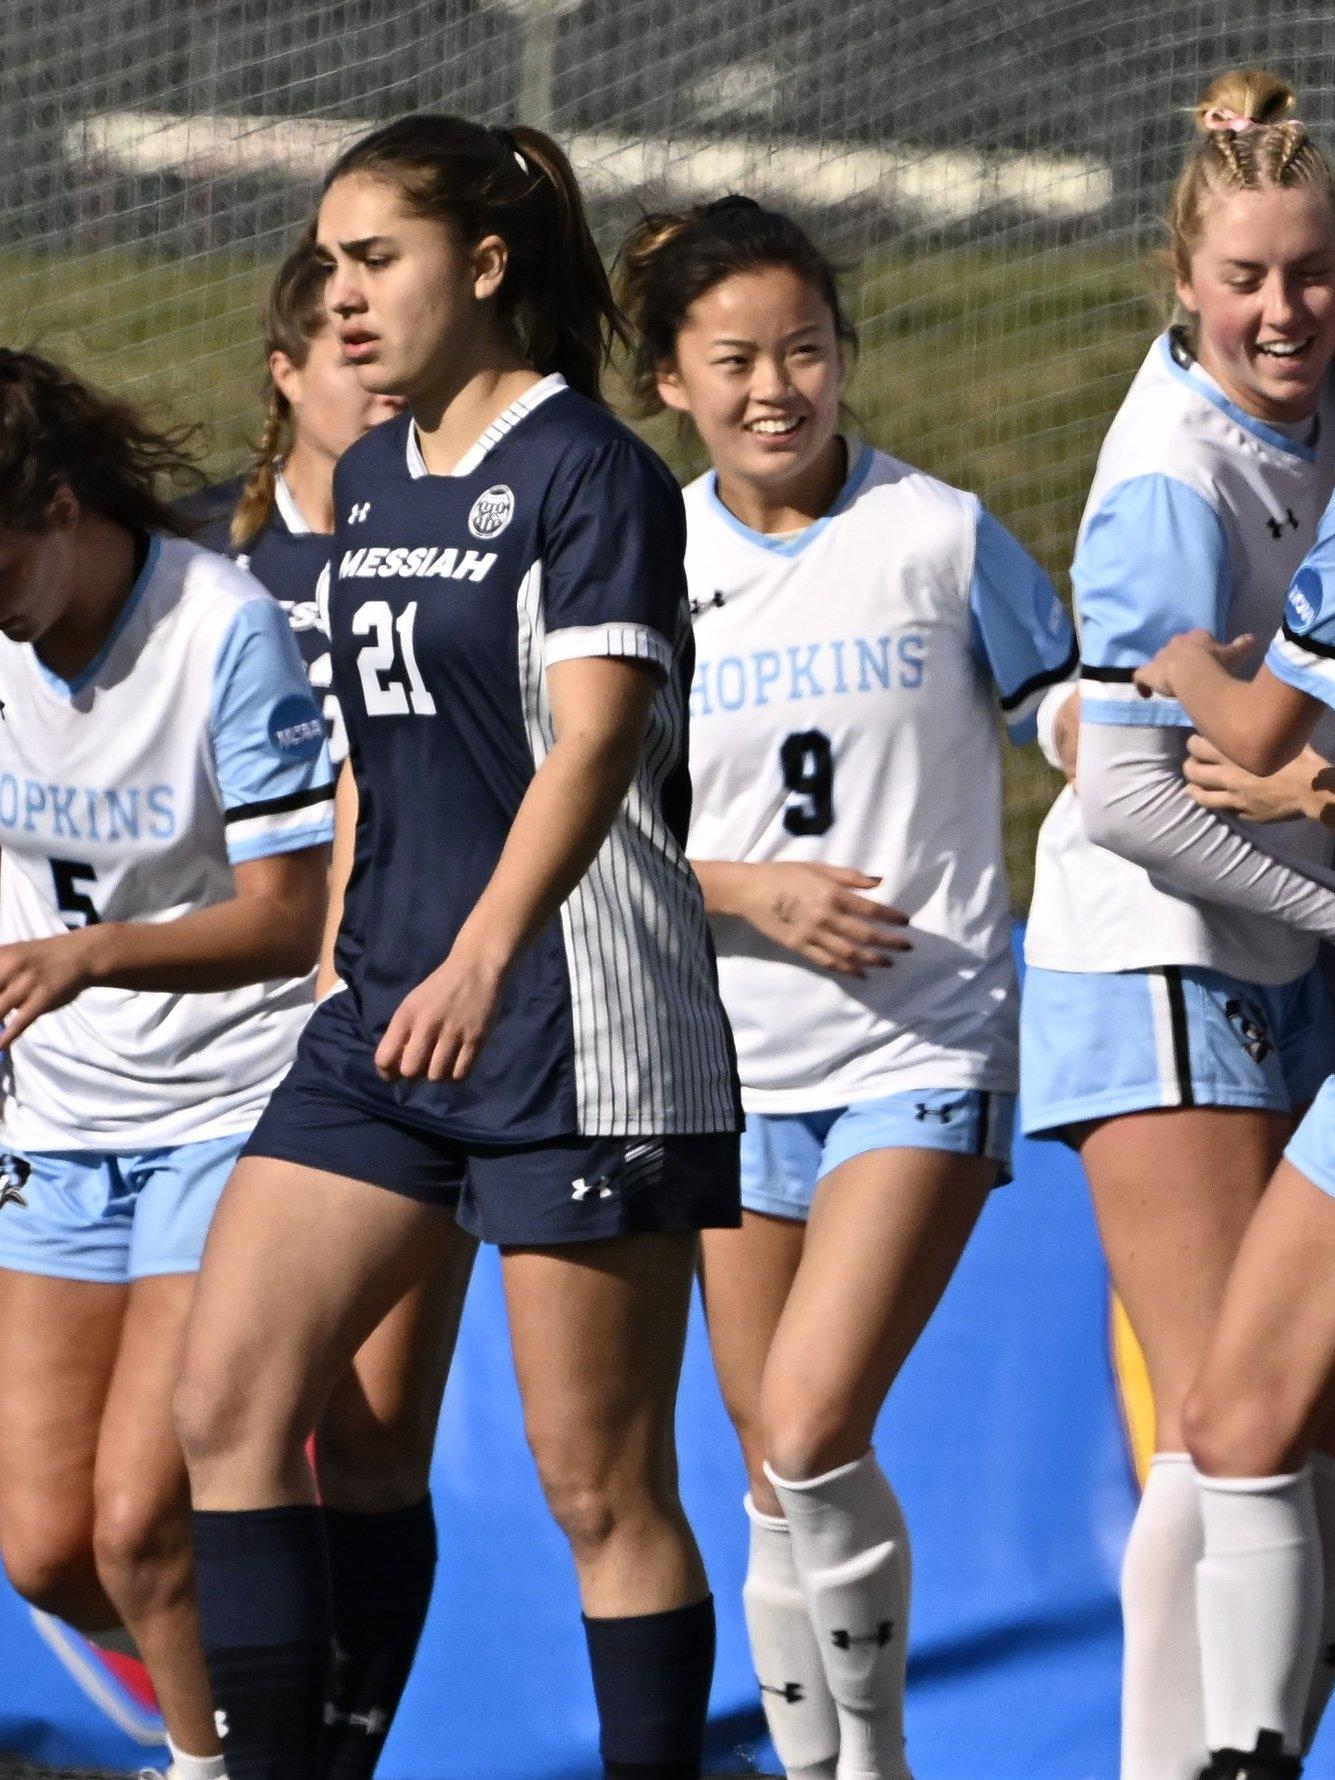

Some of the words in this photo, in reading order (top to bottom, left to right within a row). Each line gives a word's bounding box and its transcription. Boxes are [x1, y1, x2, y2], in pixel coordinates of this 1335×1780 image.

[338, 546, 498, 582] MESSIAH
[352, 600, 438, 717] 21
[780, 729, 836, 838] 9
[49, 856, 101, 930] 5
